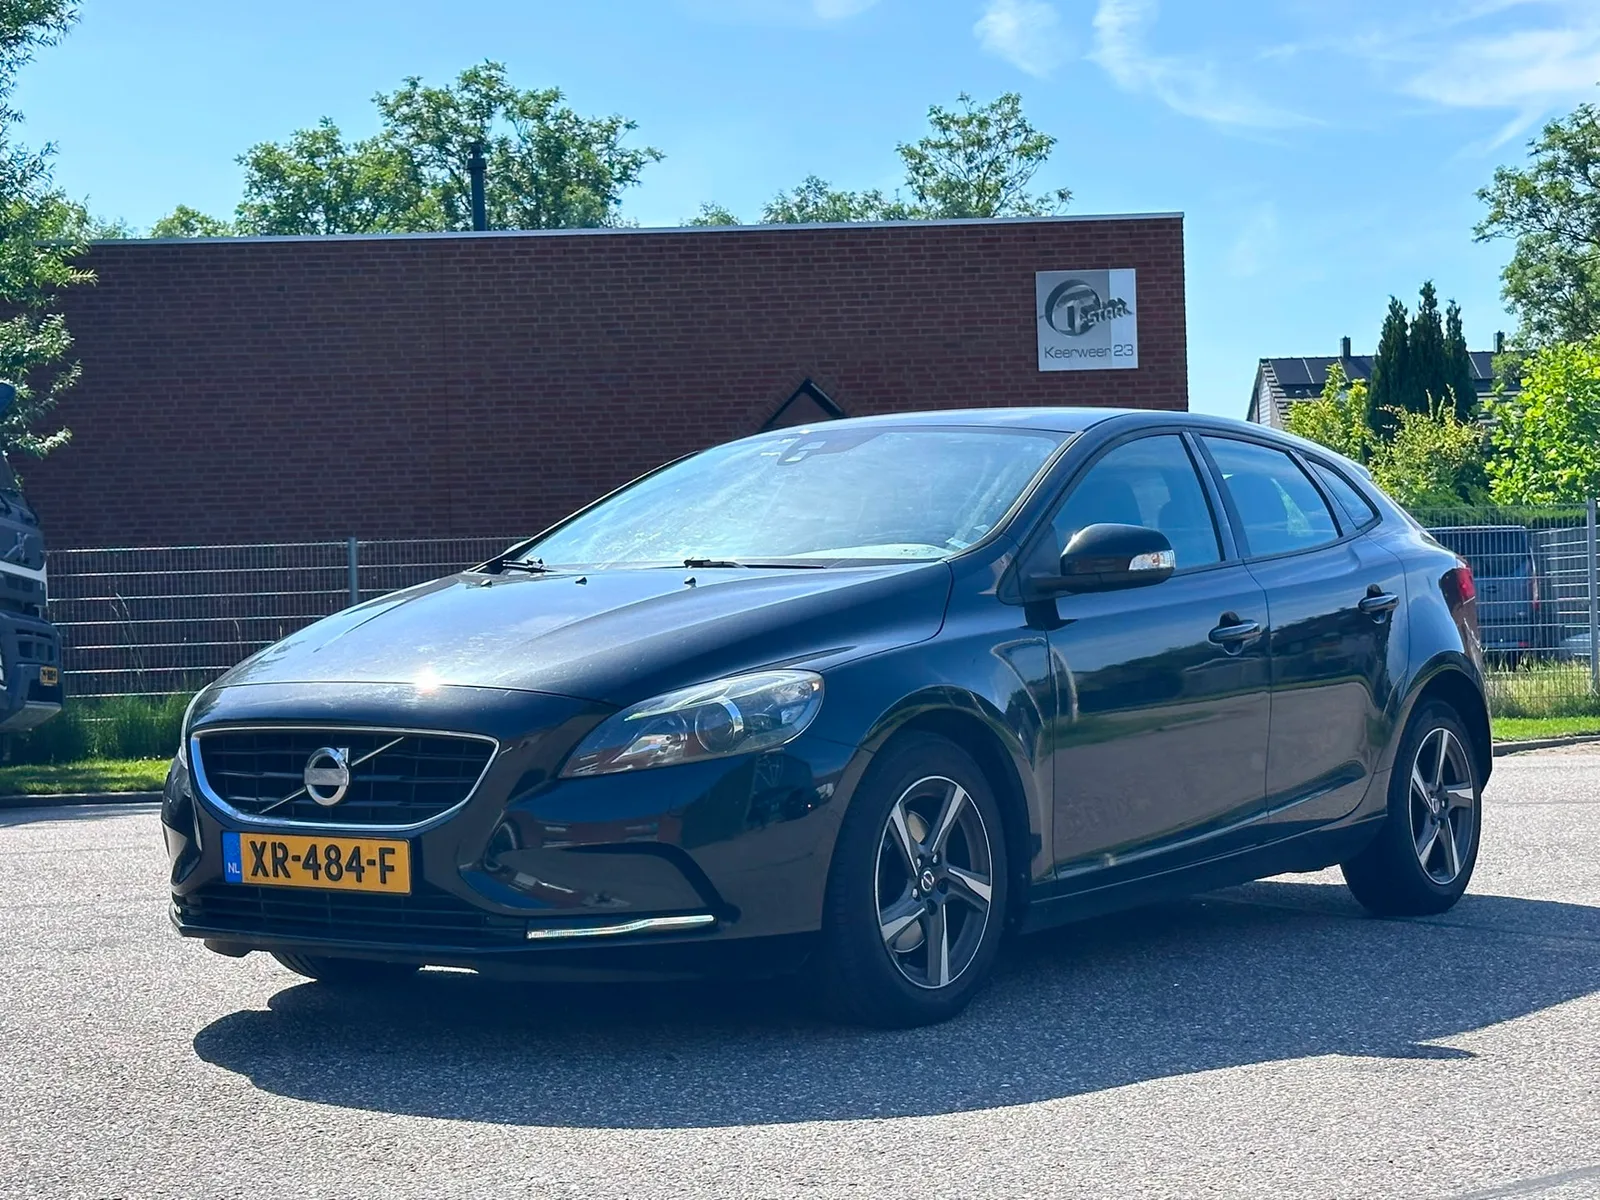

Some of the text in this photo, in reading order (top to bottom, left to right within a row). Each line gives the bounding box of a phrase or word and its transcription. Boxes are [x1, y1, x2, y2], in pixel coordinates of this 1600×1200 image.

[1044, 344, 1134, 359] Keerweer 23
[228, 863, 240, 874] NL
[249, 840, 396, 884] XR-484-F
